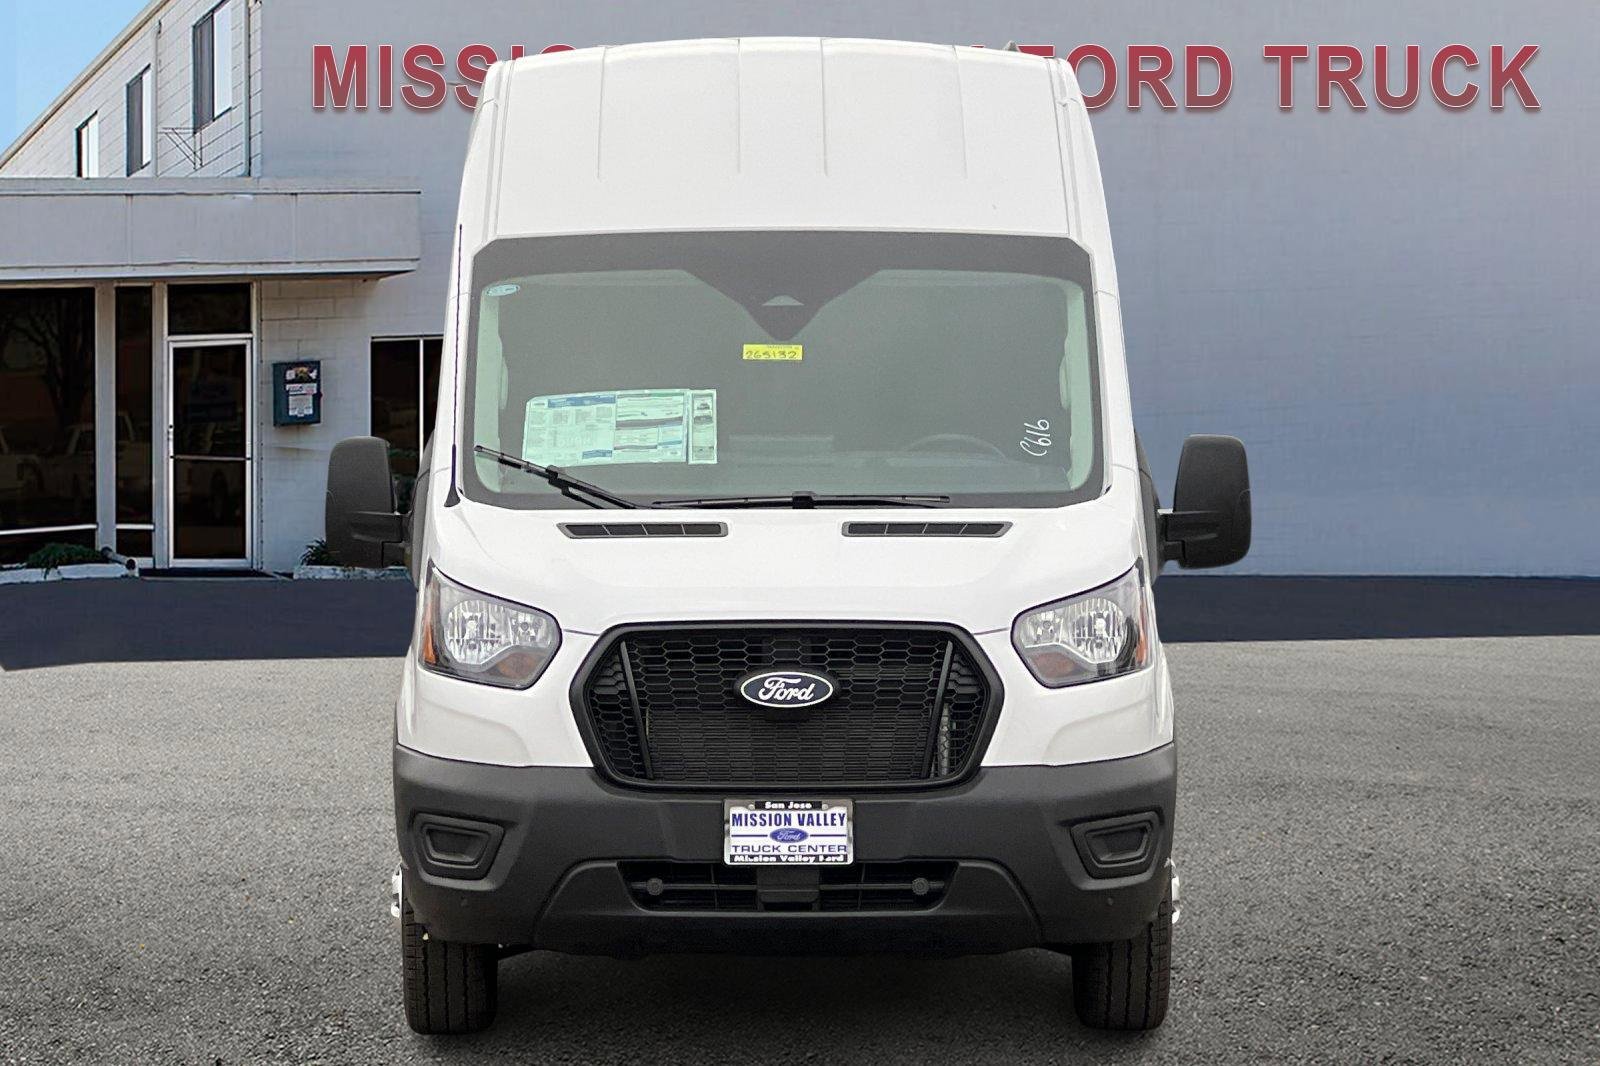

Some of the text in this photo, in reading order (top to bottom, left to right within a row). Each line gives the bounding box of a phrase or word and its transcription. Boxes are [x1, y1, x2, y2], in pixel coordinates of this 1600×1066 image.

[312, 44, 578, 109] MISS
[1263, 44, 1542, 109] TRUCK
[758, 677, 816, 700] Ford
[764, 801, 785, 809] San
[731, 813, 846, 827] MISSION VALLEY
[777, 830, 801, 841] Ford
[732, 845, 847, 853] TRUCK CENTER
[780, 855, 816, 863] Valley
